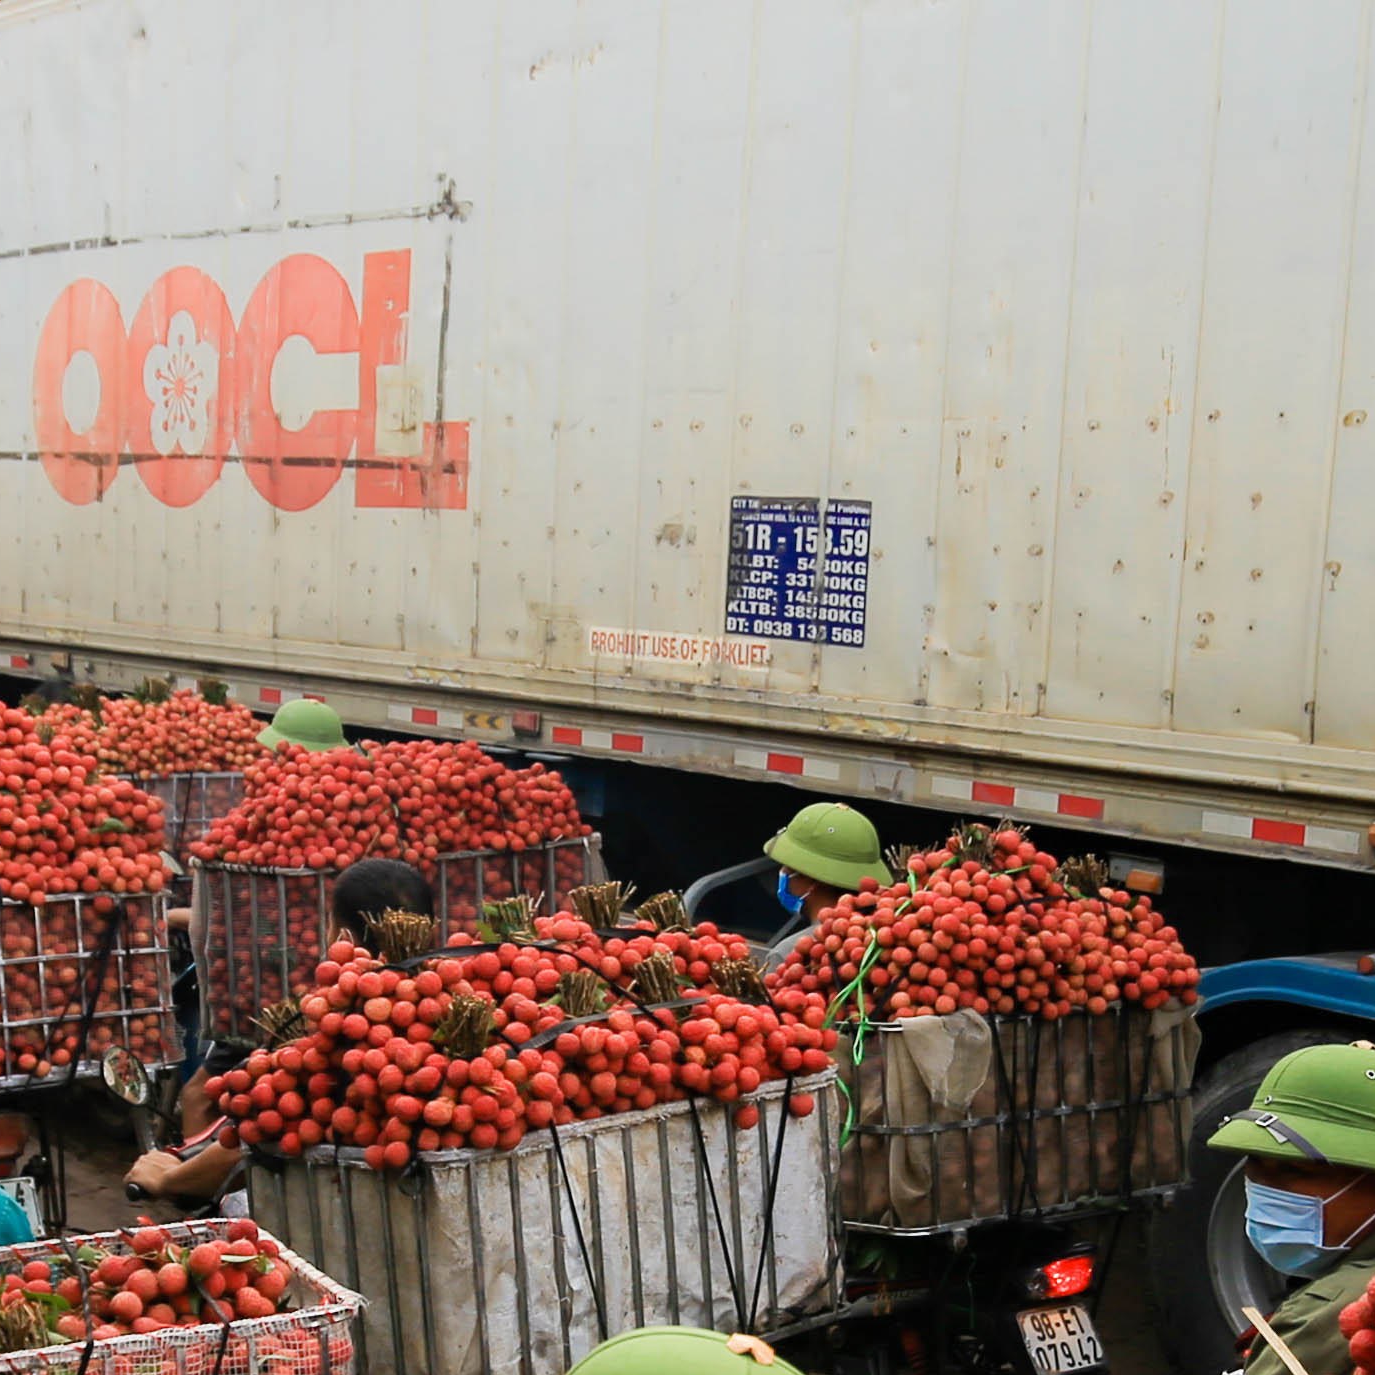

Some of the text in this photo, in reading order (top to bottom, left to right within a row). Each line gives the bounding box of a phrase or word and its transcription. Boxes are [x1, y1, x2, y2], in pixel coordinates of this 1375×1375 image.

[34, 249, 468, 511] OOCL
[652, 637, 677, 657] USE
[680, 639, 698, 660] OF
[753, 620, 793, 637] 0938
[831, 627, 864, 645] 568
[1030, 1308, 1085, 1341] 98-E1
[1035, 1336, 1103, 1371] 079.42
